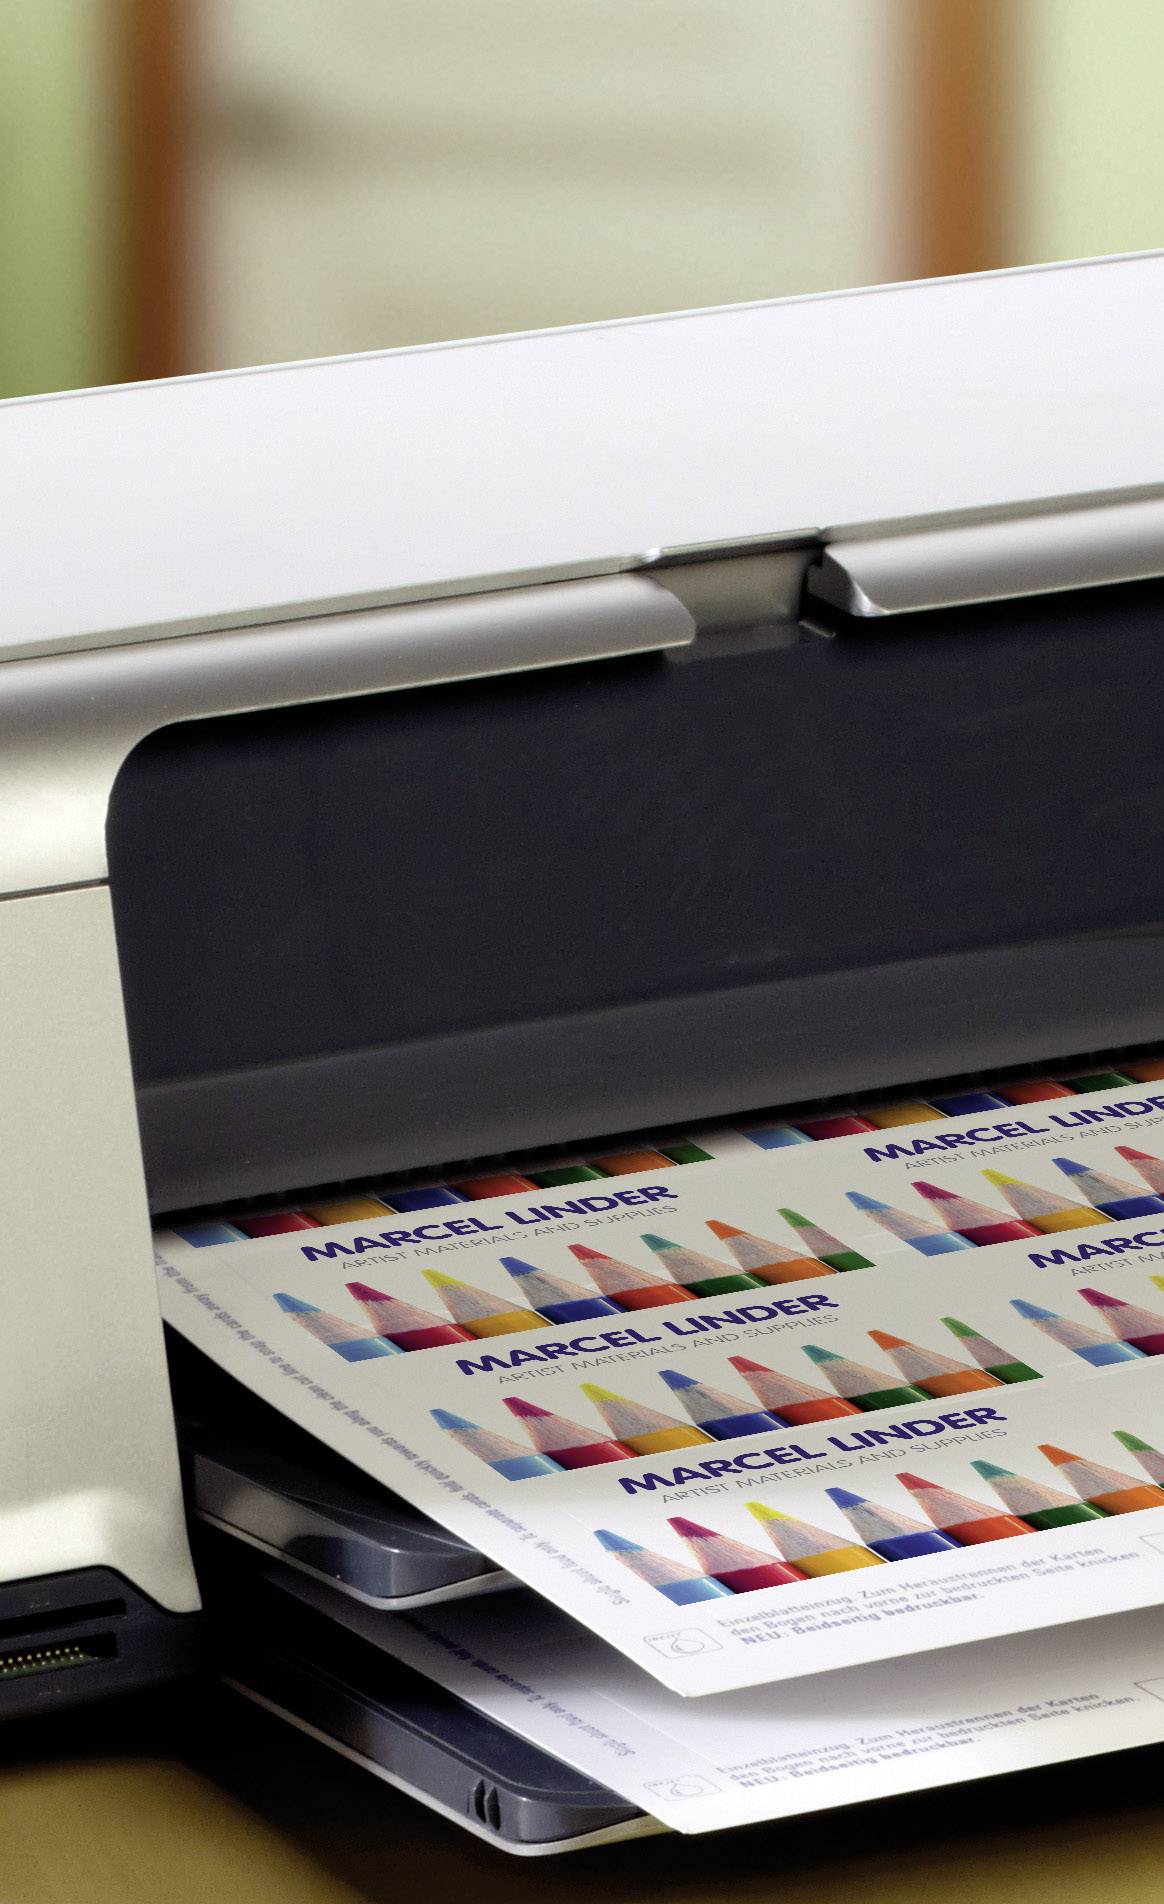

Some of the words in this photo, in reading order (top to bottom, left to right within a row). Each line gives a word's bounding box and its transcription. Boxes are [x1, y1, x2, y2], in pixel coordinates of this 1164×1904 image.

[864, 1121, 1049, 1162] MARCEL
[905, 1153, 965, 1169] ARTIST
[971, 1133, 1074, 1158] MATERIALS
[1080, 1125, 1122, 1139] AND
[301, 1216, 504, 1261] MARCEL
[505, 1186, 678, 1225] LINDER
[342, 1252, 407, 1270] ARTIST
[414, 1231, 528, 1258] MATERIALS
[534, 1221, 581, 1237] AND
[588, 1205, 678, 1226] SUPPLIES
[1072, 1259, 1133, 1277] ARTIST
[194, 1294, 220, 1311] away
[215, 1312, 241, 1329] cards
[456, 1328, 662, 1376] MARCEL
[662, 1294, 839, 1335] LINDER
[498, 1366, 565, 1384] ARTIST
[572, 1343, 686, 1371] MATERIALS
[692, 1333, 739, 1349] AND
[747, 1314, 838, 1339] SUPPLIES
[329, 1401, 348, 1411] the
[343, 1410, 371, 1426] along
[618, 1443, 827, 1494] MARCEL
[827, 1407, 1007, 1451] LINDER
[662, 1482, 729, 1503] ARTIST
[737, 1459, 852, 1488] MATERIALS
[858, 1448, 905, 1465] AND
[913, 1428, 1007, 1453] SUPPLIES
[860, 1585, 895, 1599] Zum
[901, 1563, 1018, 1592] Heraustrennen
[1021, 1558, 1045, 1569] der
[1050, 1548, 1105, 1562] Karten
[730, 1623, 757, 1636] den
[764, 1612, 815, 1630] Bogen
[820, 1604, 859, 1618] nach
[867, 1592, 907, 1611] vorne
[914, 1590, 937, 1600] zur
[943, 1572, 1031, 1593] bedruckten
[1032, 1563, 1074, 1577] Seite
[791, 1612, 881, 1635] Beidseitig
[729, 1770, 758, 1781] den
[762, 1759, 814, 1775] Bogen
[818, 1750, 856, 1763] nach
[863, 1740, 906, 1757] vorne
[912, 1735, 933, 1744] zur
[940, 1717, 1026, 1739] bedruckten
[1028, 1709, 1070, 1721] Seite
[856, 1731, 893, 1746] Zum
[896, 1709, 1013, 1736] Heraustrennen
[1017, 1703, 1042, 1714] der
[1046, 1693, 1100, 1708] Karten
[789, 1755, 878, 1778] Beidseitig
